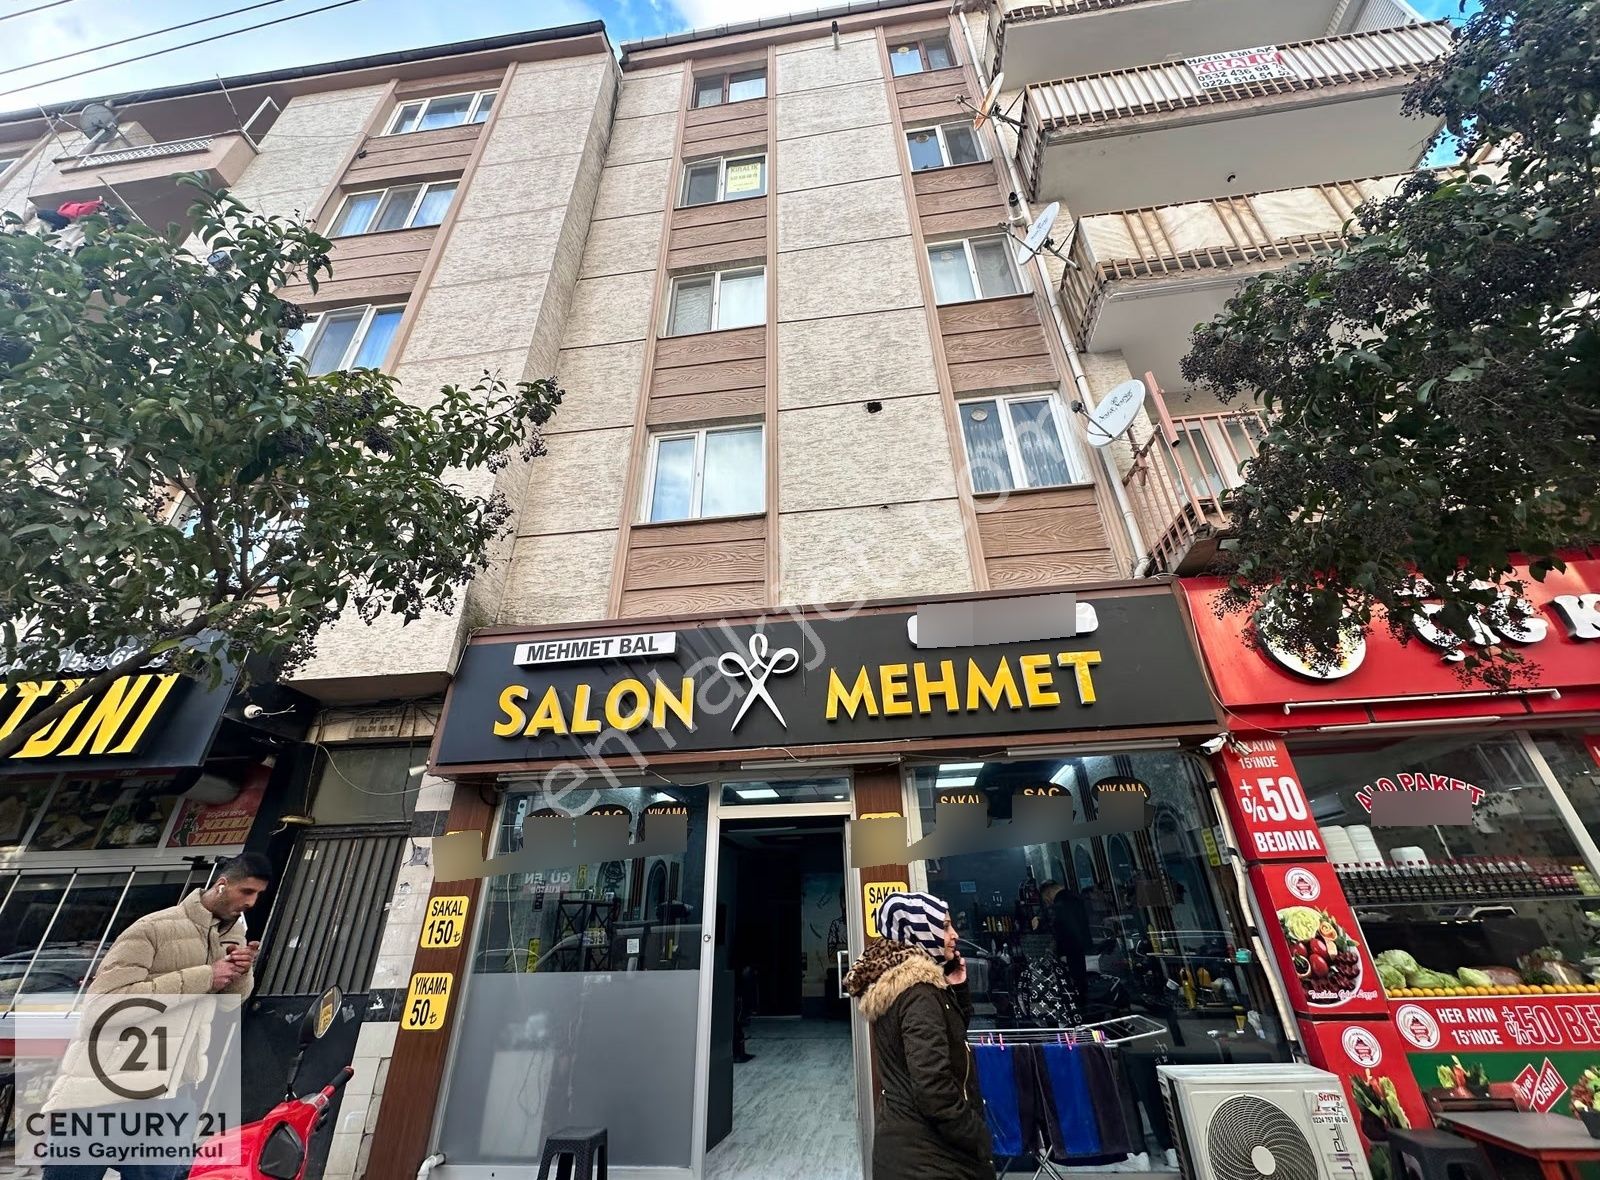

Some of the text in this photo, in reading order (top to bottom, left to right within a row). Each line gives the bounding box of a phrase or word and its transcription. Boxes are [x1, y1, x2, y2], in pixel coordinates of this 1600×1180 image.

[1198, 72, 1228, 82] 0532
[1202, 78, 1231, 88] 0224
[1260, 72, 1274, 80] 51
[526, 635, 659, 662] MEHMET BAL
[493, 650, 1102, 738] SALON MEHMET
[0, 673, 180, 759] TUNI
[1253, 829, 1321, 853] BEDAVA
[431, 900, 464, 917] SAKAL
[414, 976, 448, 995] YIKAMA
[1436, 1007, 1498, 1024] HER AYIN
[1554, 1004, 1600, 1045] BE
